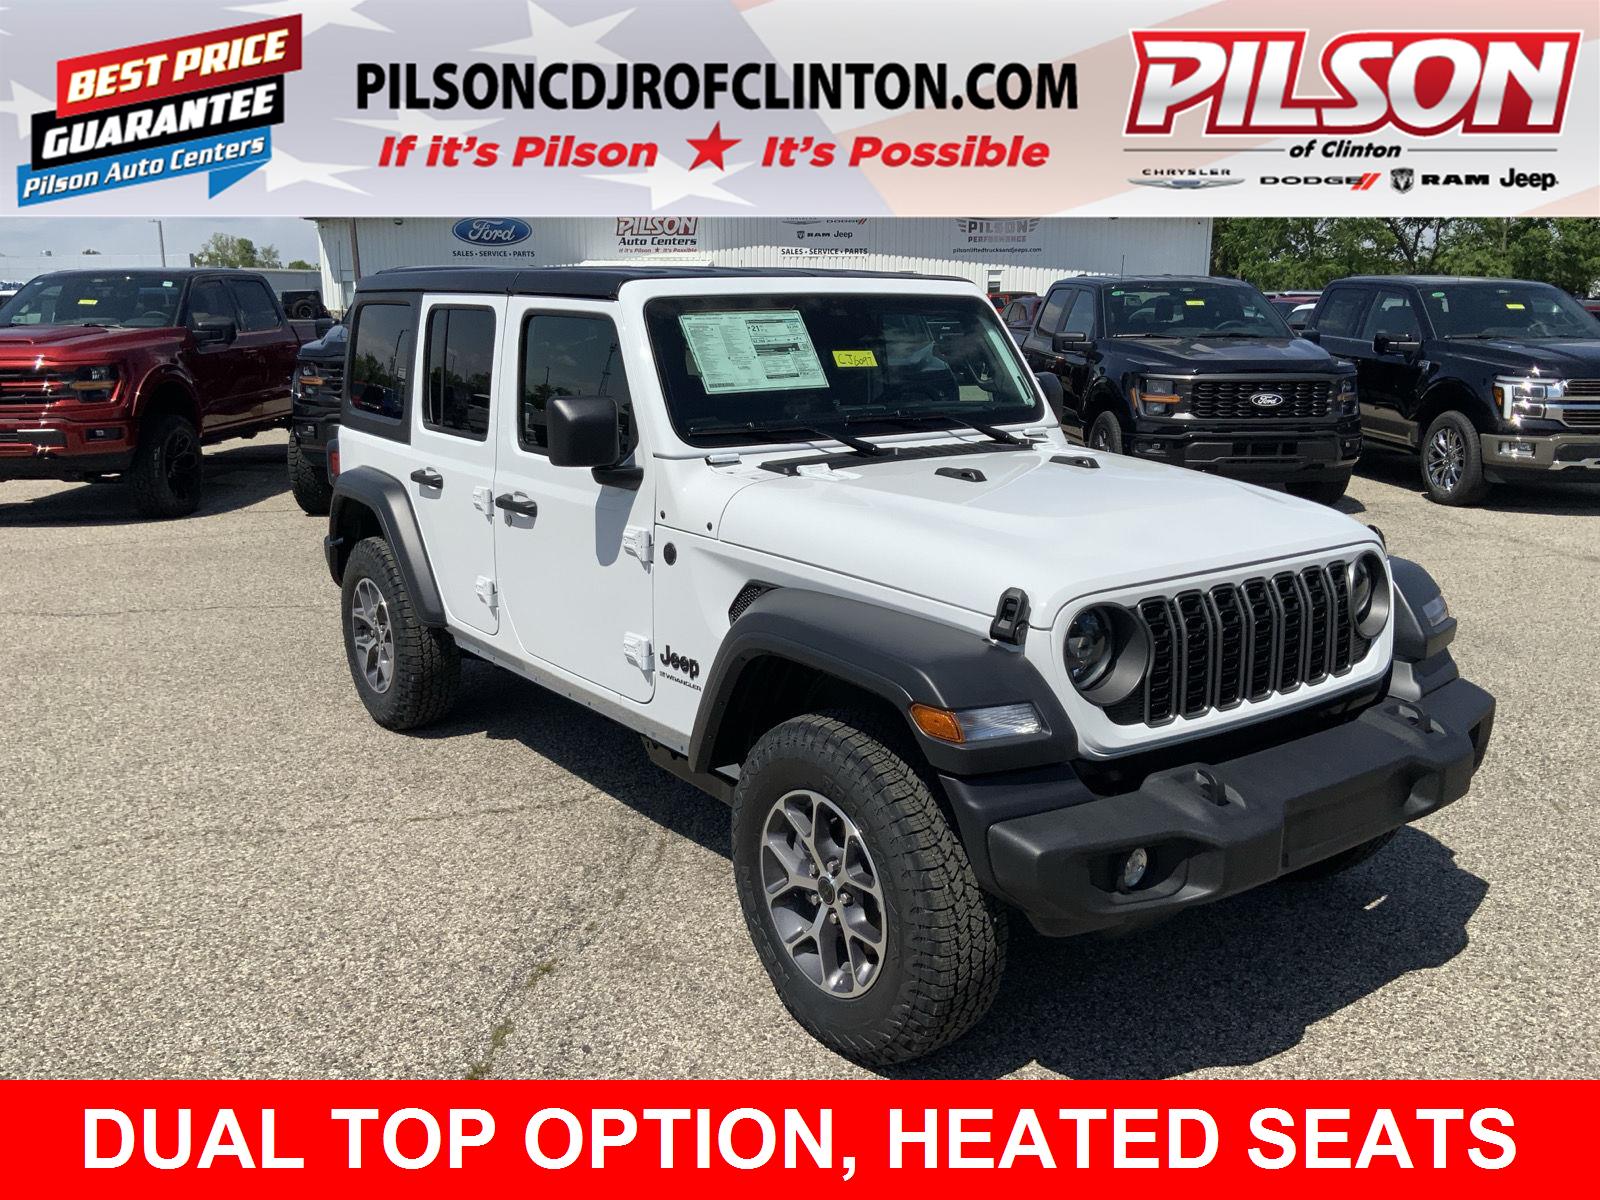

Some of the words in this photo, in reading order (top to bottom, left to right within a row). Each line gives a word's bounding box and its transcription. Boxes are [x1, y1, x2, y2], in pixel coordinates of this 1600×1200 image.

[468, 219, 515, 241] Ford
[616, 216, 698, 236] PILSON
[968, 219, 1028, 233] PILSON
[833, 230, 853, 239] Jeep
[618, 237, 647, 246] Auto
[651, 237, 698, 246] Centers
[512, 250, 535, 258] PARTS
[844, 247, 868, 255] PARTS
[660, 644, 700, 680] Jeep
